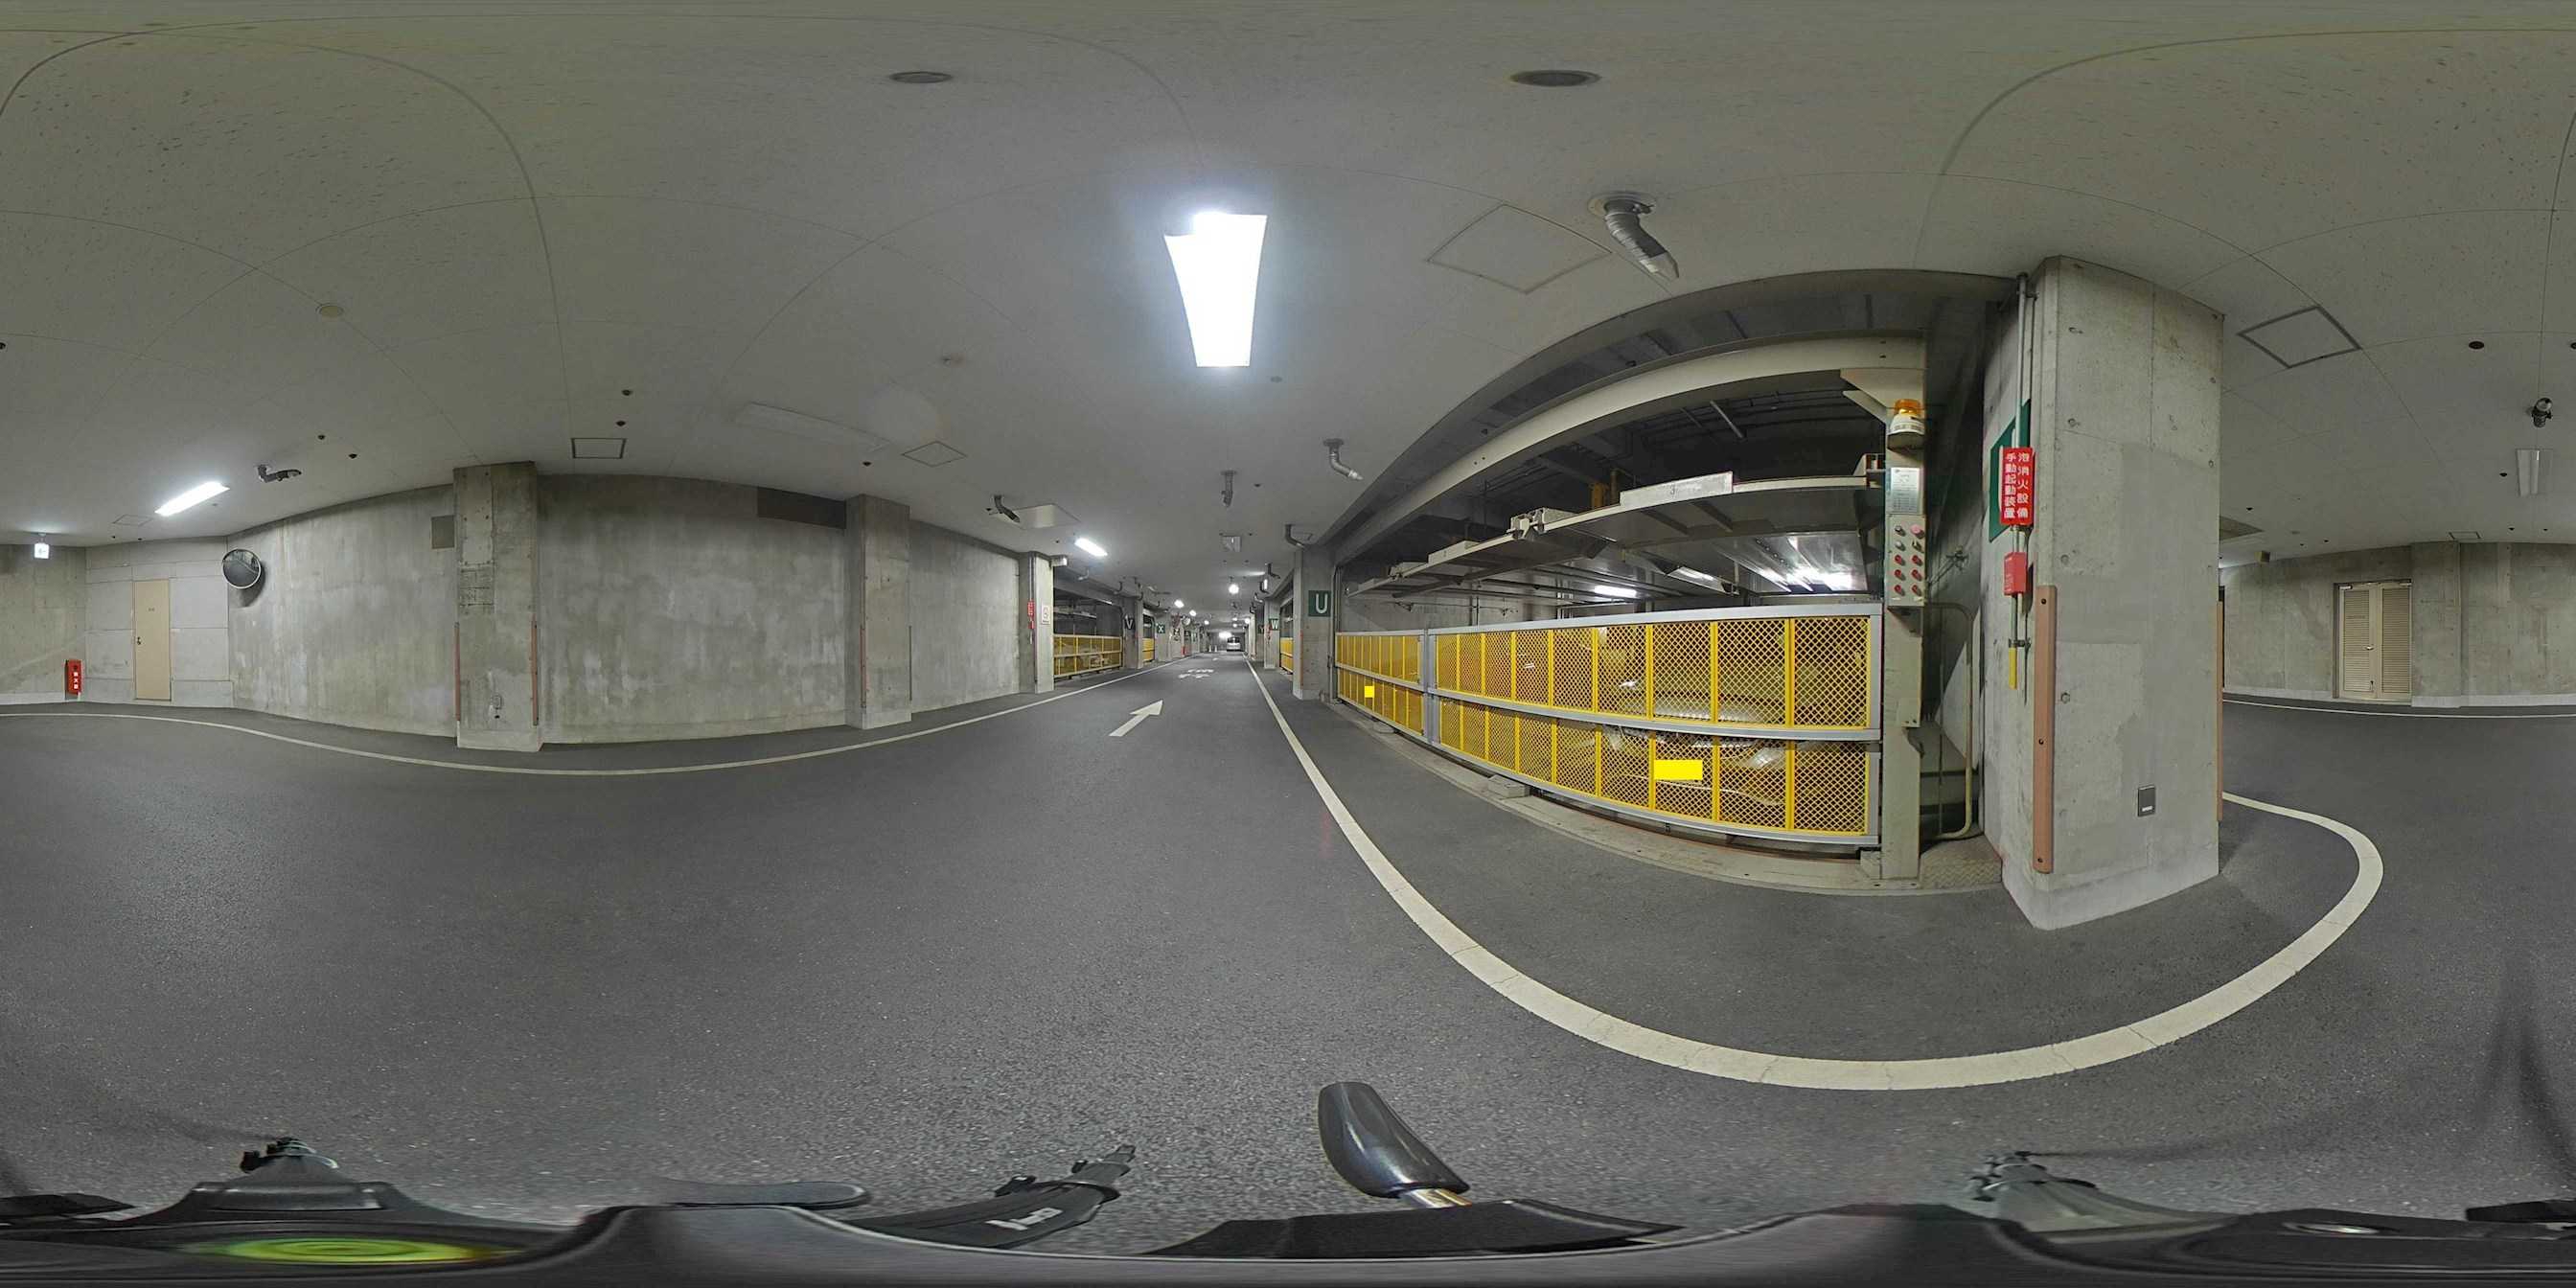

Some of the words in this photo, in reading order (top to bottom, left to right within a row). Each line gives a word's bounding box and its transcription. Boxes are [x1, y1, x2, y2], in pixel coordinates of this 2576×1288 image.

[2005, 452, 2016, 518] 手動起動装置
[2017, 452, 2030, 518] 泡消火設備
[1316, 593, 1328, 613] U
[1125, 617, 1133, 629] V
[1271, 620, 1278, 629] W
